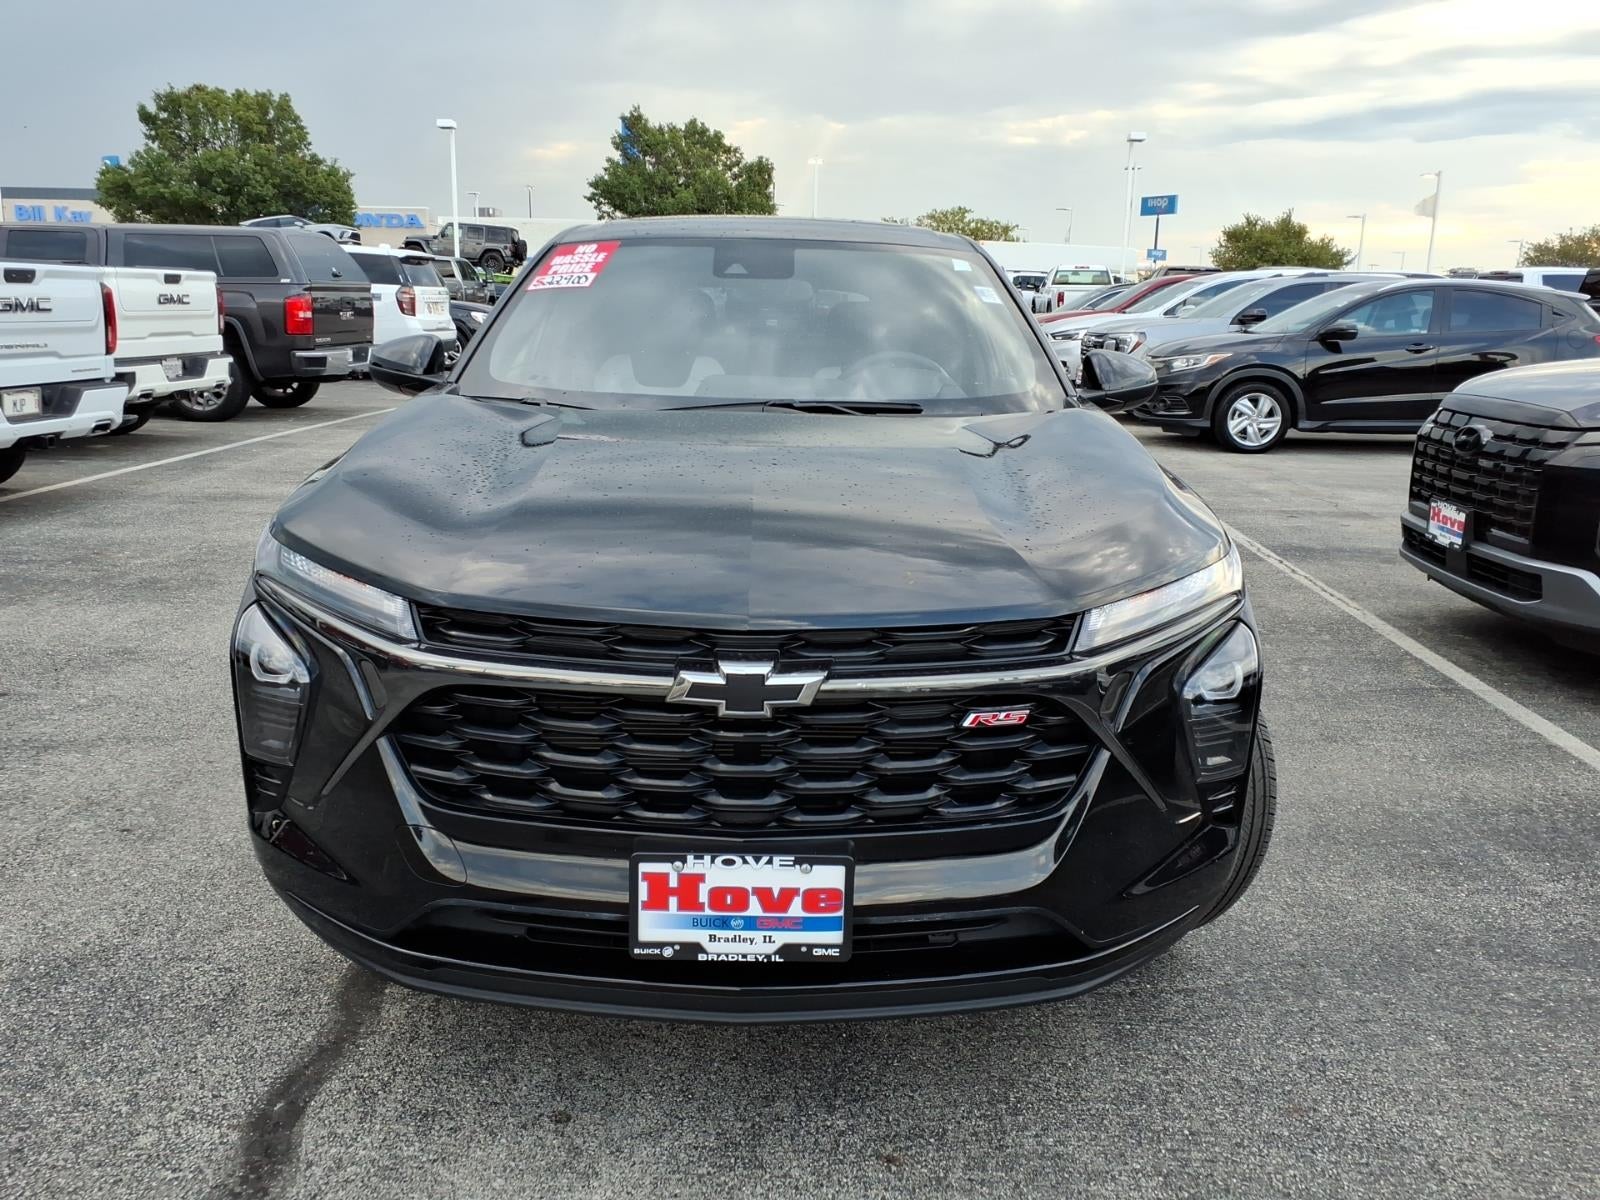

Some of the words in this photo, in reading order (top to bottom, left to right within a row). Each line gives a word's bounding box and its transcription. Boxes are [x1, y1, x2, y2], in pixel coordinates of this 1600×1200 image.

[15, 205, 45, 221] Bill
[574, 244, 598, 254] NO
[550, 253, 607, 265] HASSLE
[547, 263, 596, 274] PRICE
[0, 297, 52, 312] GMC
[158, 294, 190, 304] GMC
[1431, 506, 1465, 532] Hove
[962, 709, 1030, 727] RS
[687, 855, 795, 870] HOVE
[641, 872, 844, 915] Hove
[692, 918, 729, 928] BUICK
[756, 917, 804, 929] GMC
[708, 934, 757, 946] Bradley,
[763, 935, 776, 944] IL
[813, 948, 840, 956] GMC
[698, 954, 767, 963] BRADLEY,
